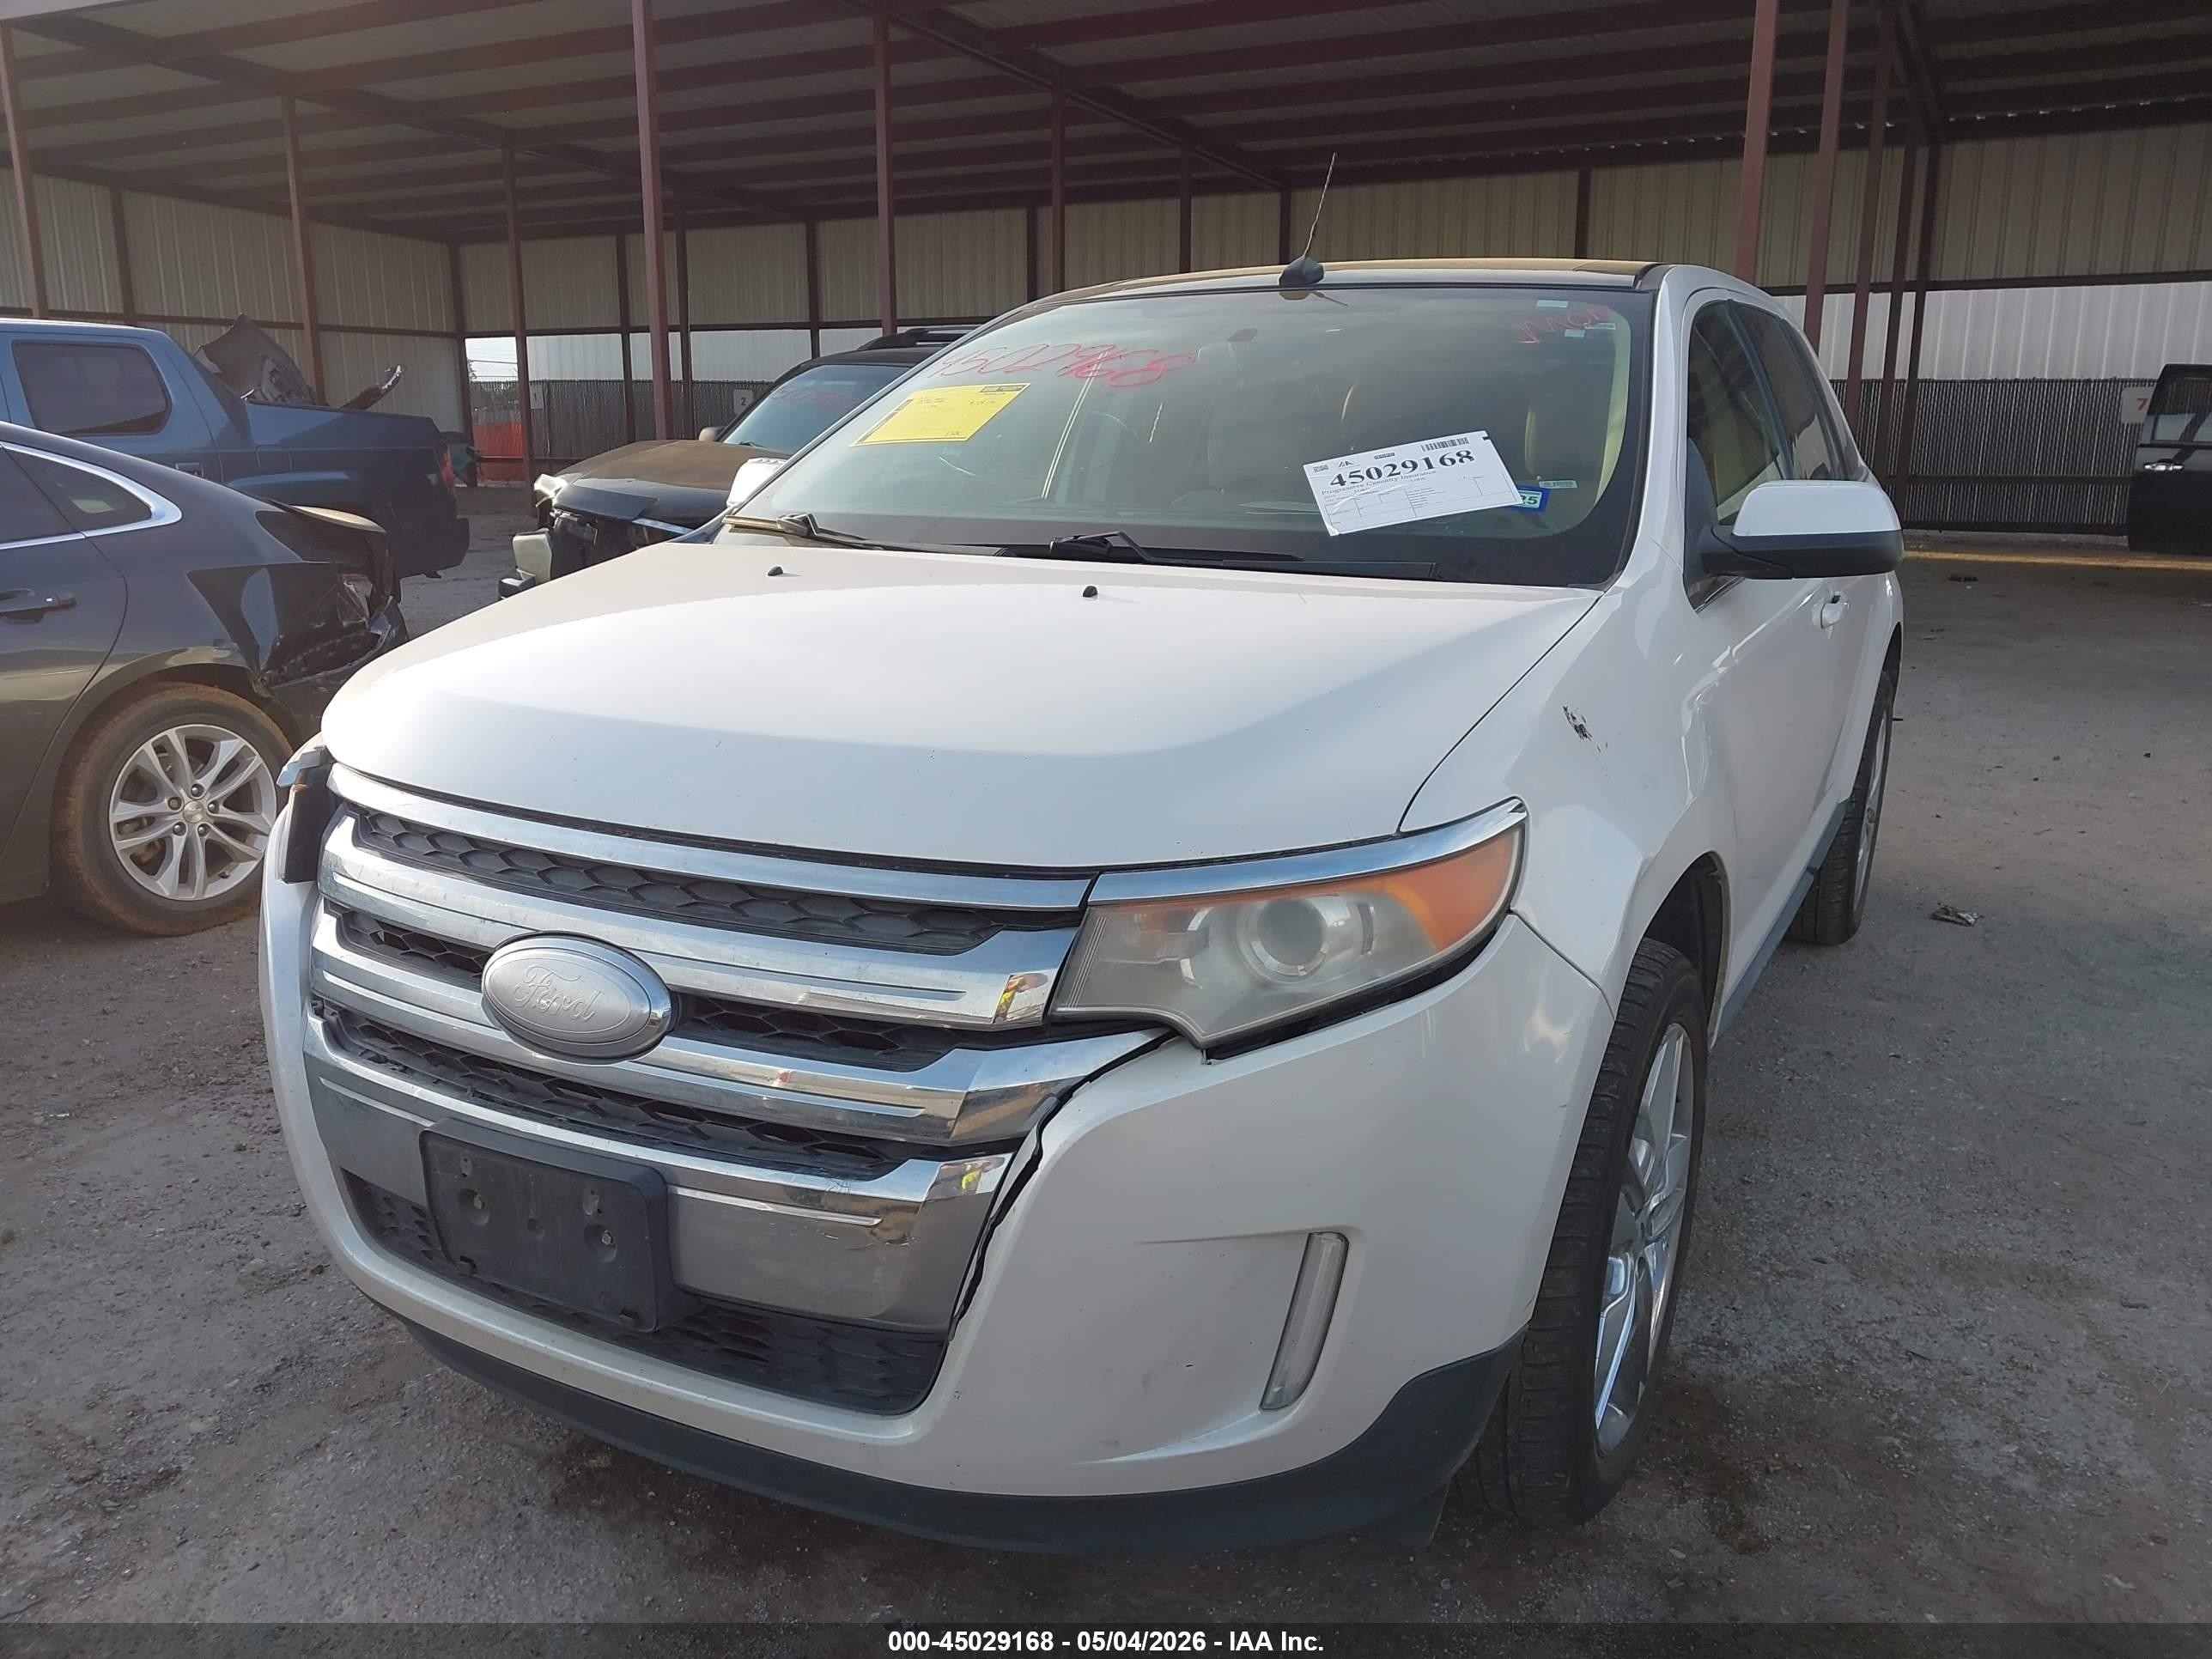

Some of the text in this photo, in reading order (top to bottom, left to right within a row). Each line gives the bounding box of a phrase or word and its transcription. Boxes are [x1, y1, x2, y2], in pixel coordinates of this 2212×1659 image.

[740, 397, 747, 406] 2
[1329, 449, 1475, 487] 45029168
[514, 964, 603, 1024] Ford
